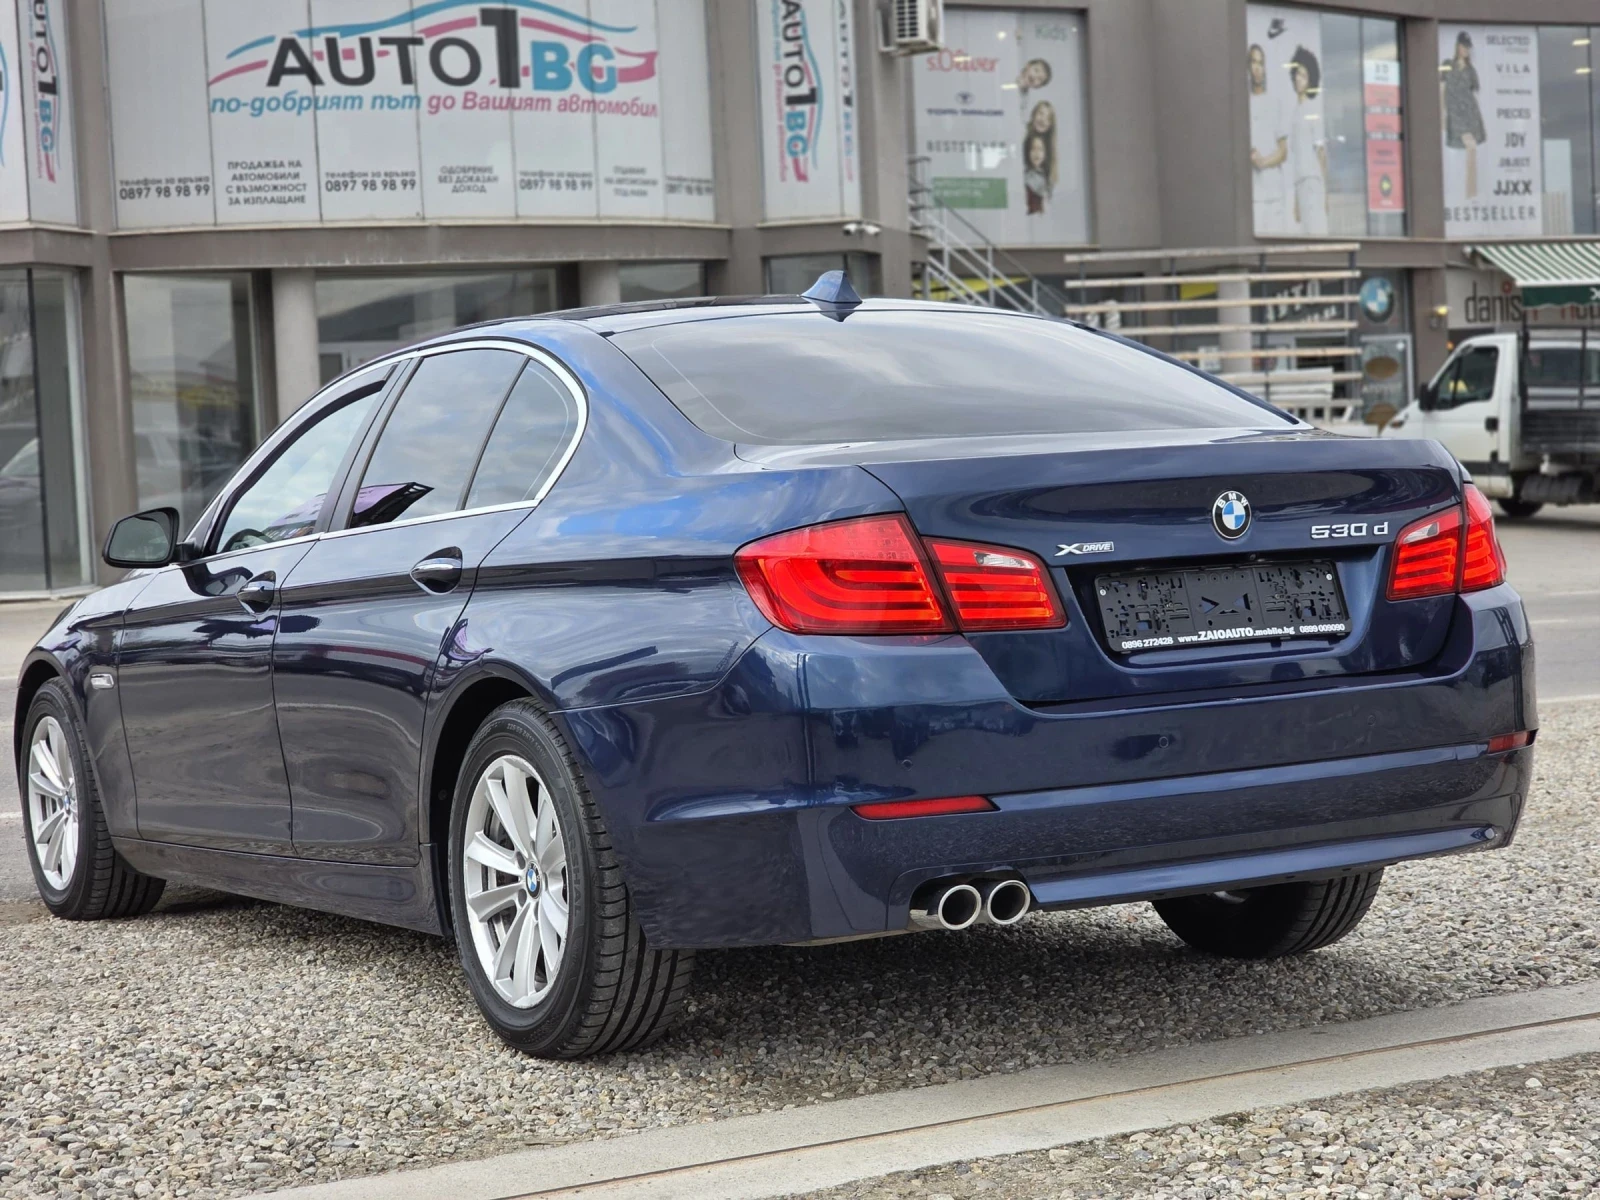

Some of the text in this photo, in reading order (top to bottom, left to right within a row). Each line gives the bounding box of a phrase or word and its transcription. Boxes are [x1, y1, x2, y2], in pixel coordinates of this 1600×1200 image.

[34, 0, 57, 153] UTO1BG
[211, 90, 659, 117] по-добрият път до Вашият автомобил
[228, 160, 302, 170] ПРОДАЖБА НА
[231, 172, 300, 182] АВТОМОБИЛИ
[325, 178, 416, 192] 0897 98 98 99
[519, 179, 545, 191] 0897
[119, 184, 210, 200] 0897 98 98 99
[236, 183, 307, 194] ВЪЗМОЖНОСТ
[1493, 180, 1532, 196] JJXX
[228, 195, 306, 206] ЗА ИЗПЛАЩАНЕ
[1217, 492, 1249, 508] BMW
[1311, 521, 1389, 539] 530 d
[1122, 640, 1143, 649] 0896
[1143, 637, 1173, 647] 272428
[1299, 625, 1318, 633] 0899
[1318, 623, 1345, 632] 009090
[559, 799, 582, 918] MARSHAL
